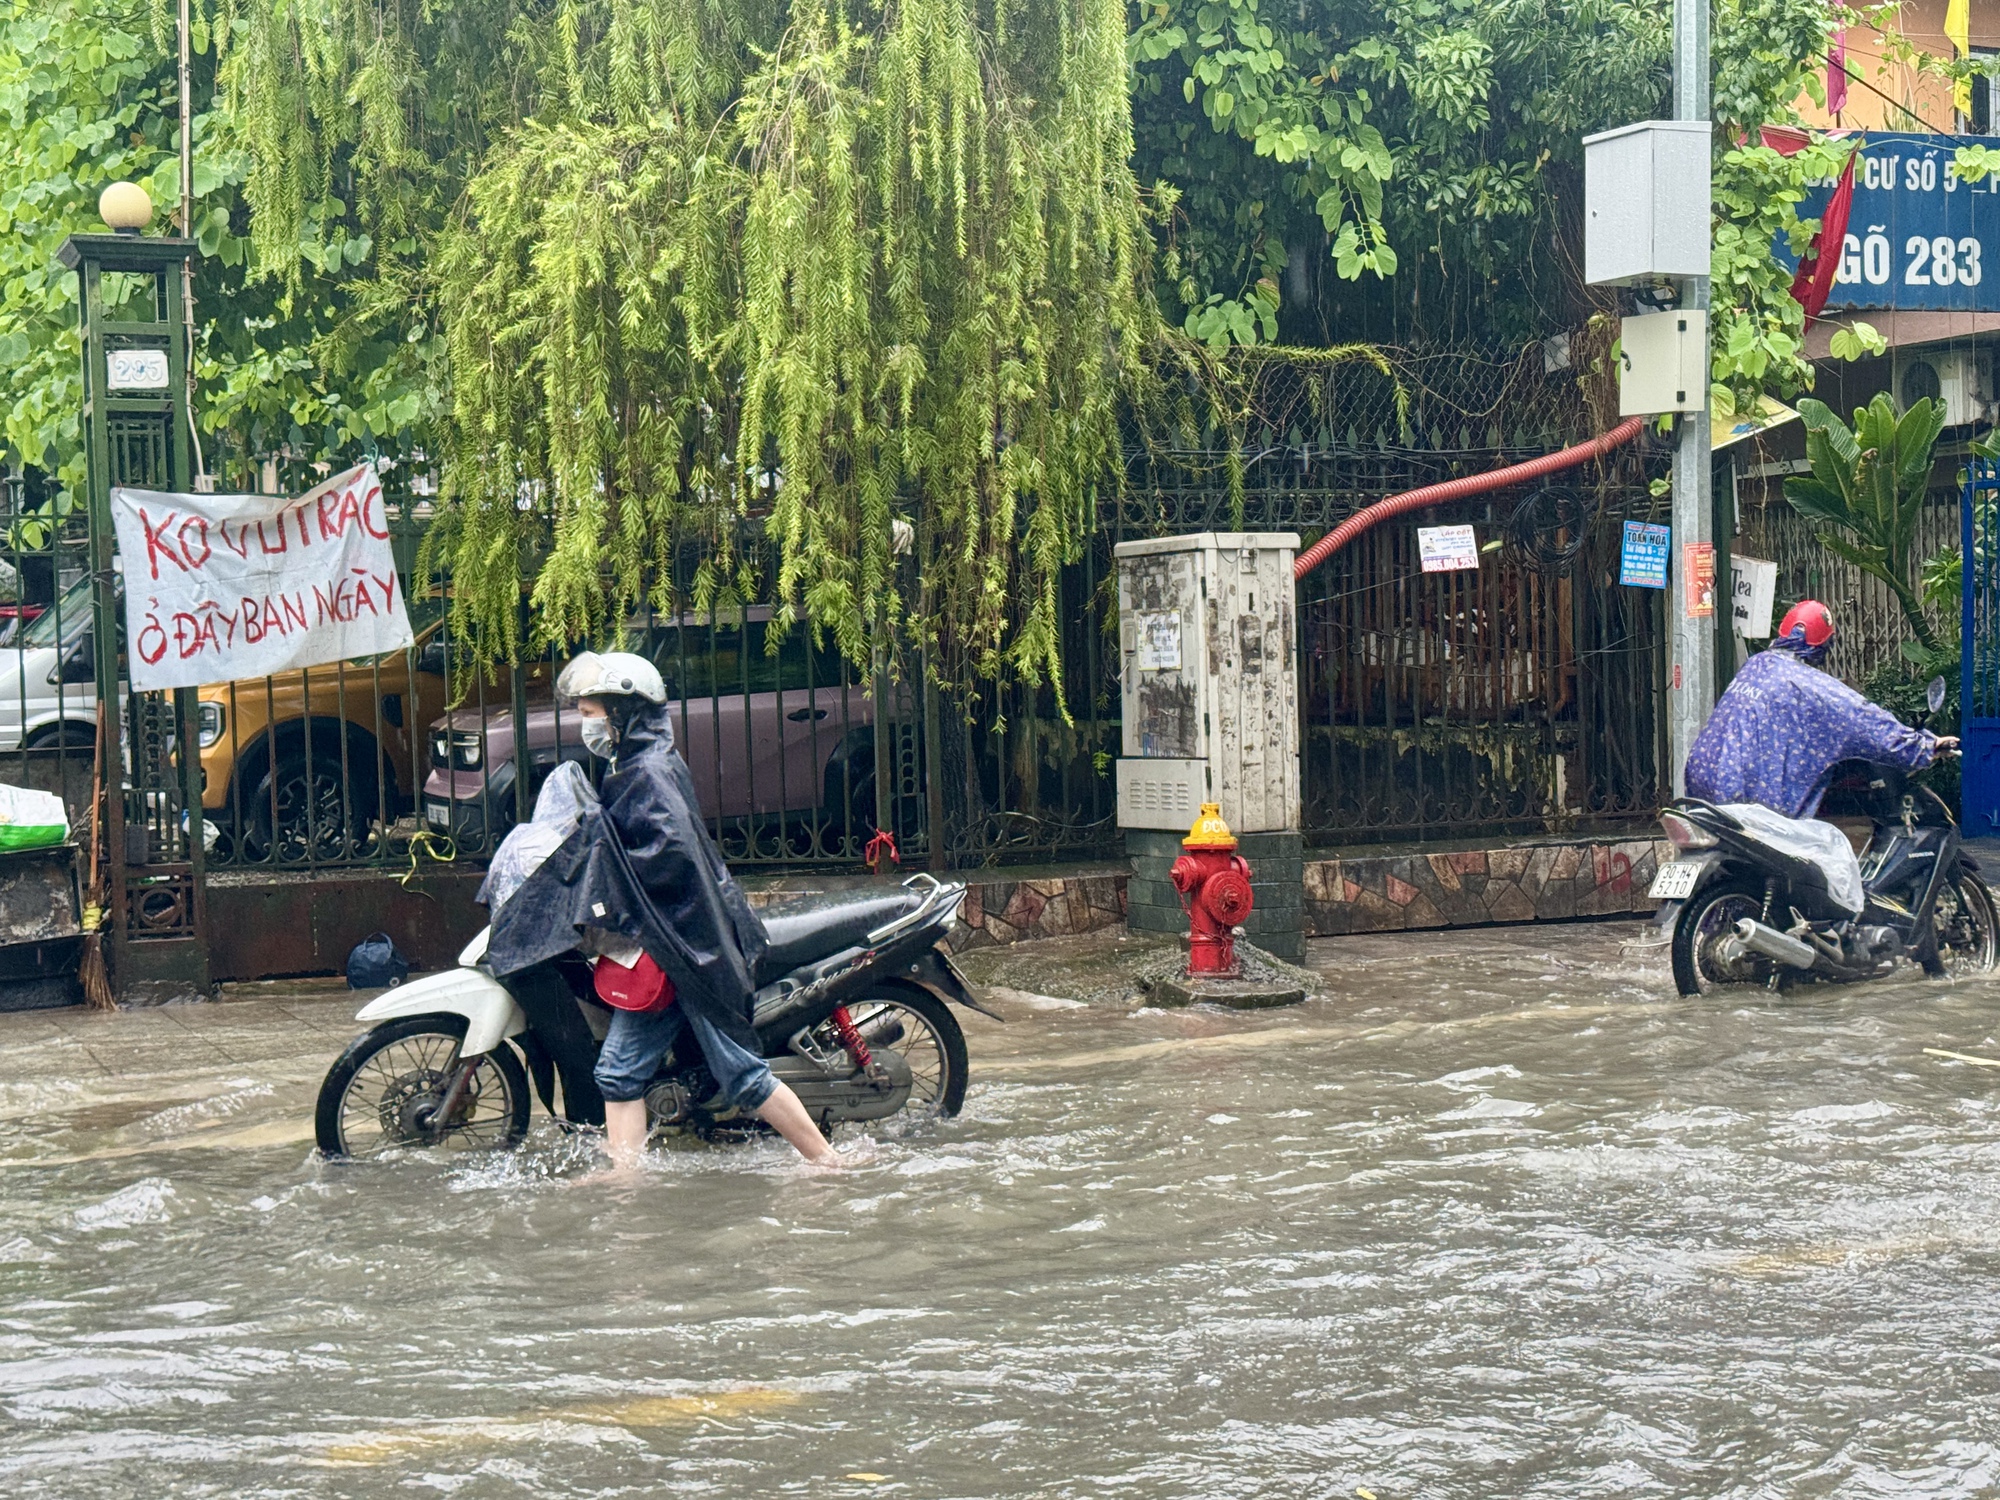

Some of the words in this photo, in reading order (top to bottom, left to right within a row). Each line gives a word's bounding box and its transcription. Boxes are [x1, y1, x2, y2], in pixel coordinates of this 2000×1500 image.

[1864, 155, 1899, 190] CƯ
[1905, 150, 1938, 191] SỐ
[1836, 224, 1890, 285] GÕ
[1905, 235, 1982, 286] 283
[1731, 568, 1752, 598] Tea
[1656, 881, 1688, 895] 5210
